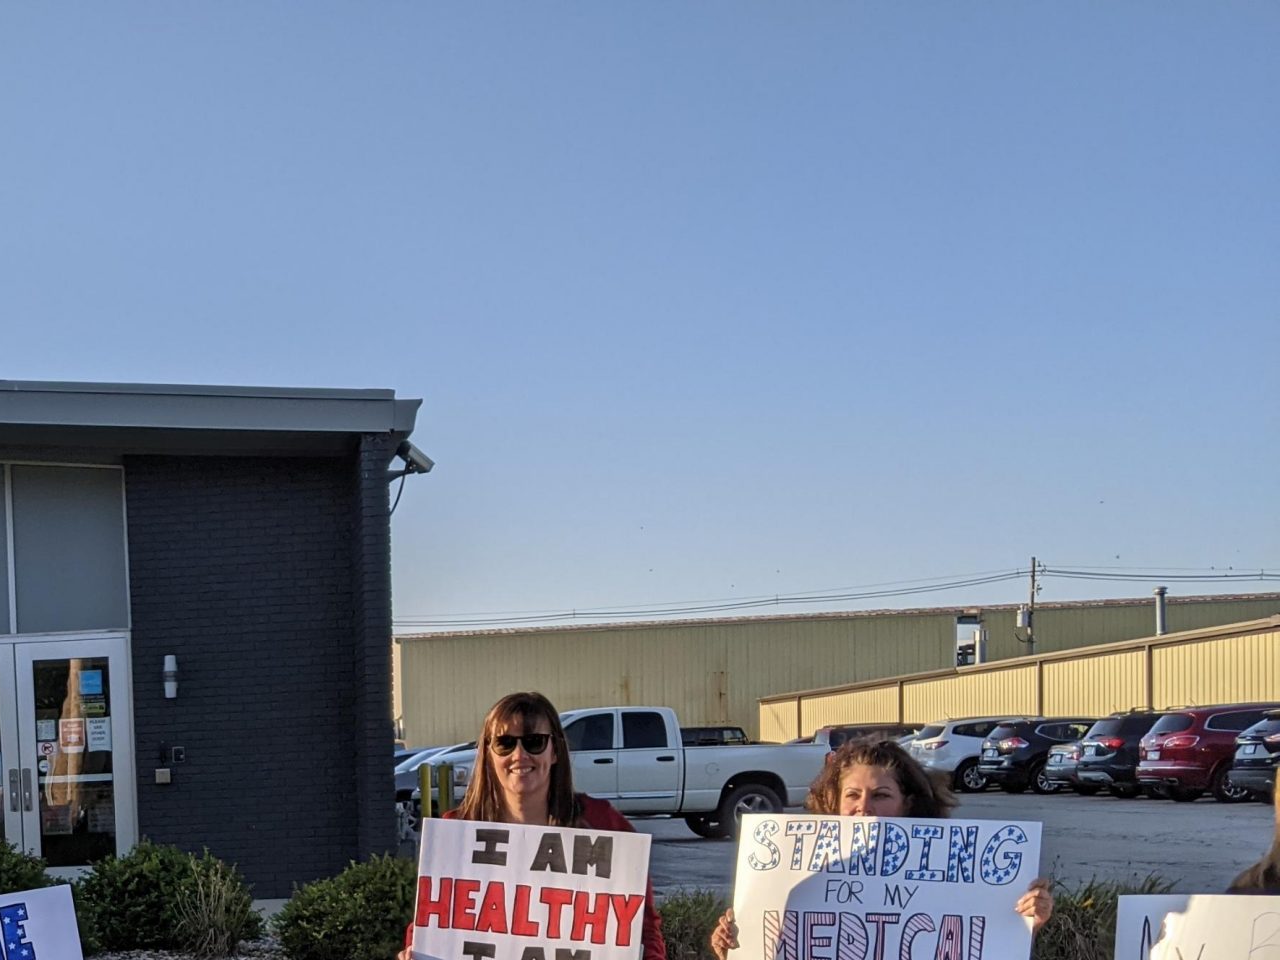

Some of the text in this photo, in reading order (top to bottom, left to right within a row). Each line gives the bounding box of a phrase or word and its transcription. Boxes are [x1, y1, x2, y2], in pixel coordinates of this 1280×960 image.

[471, 828, 613, 879] I AM
[747, 819, 1029, 886] STANDING
[415, 876, 645, 947] HEALTHY
[825, 879, 864, 905] FOR
